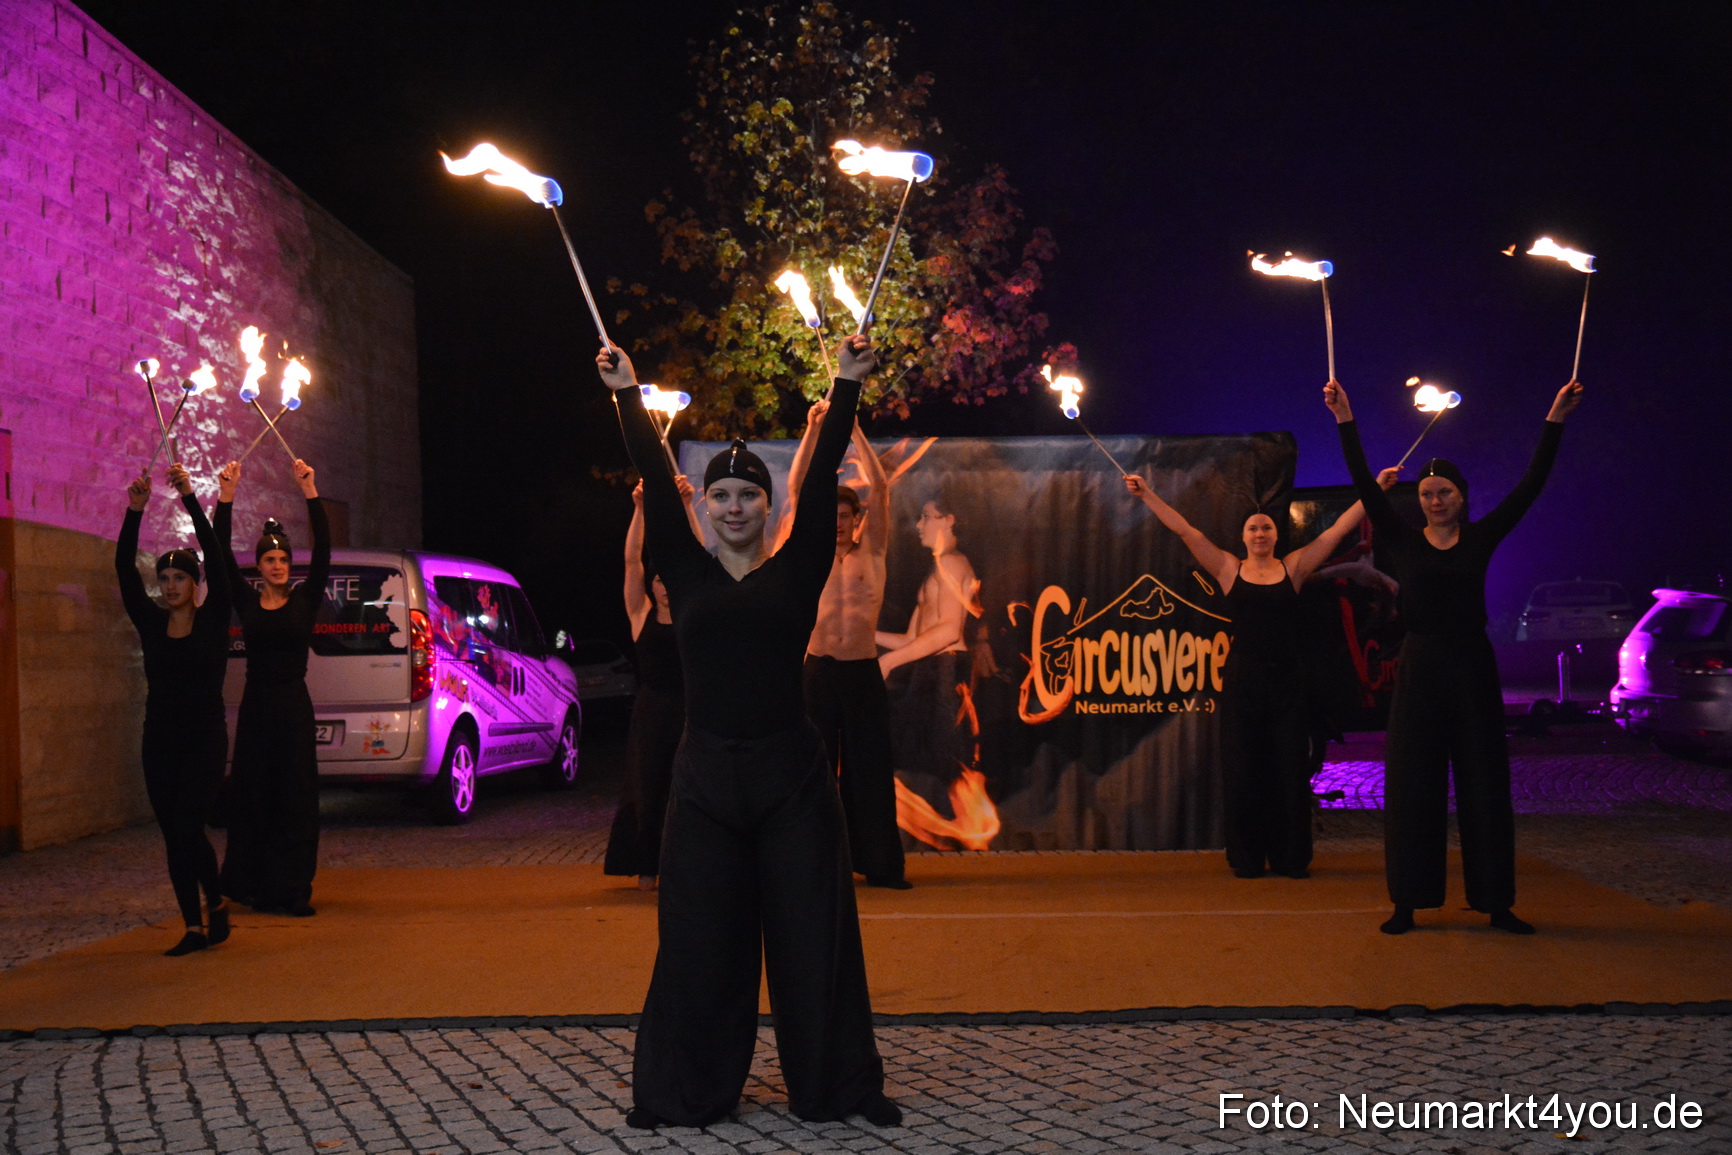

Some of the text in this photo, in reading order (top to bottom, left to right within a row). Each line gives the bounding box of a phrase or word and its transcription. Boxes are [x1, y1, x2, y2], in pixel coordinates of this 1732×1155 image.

[313, 623, 367, 634] SONDEREN
[1031, 585, 1231, 712] Circusvere
[1075, 700, 1164, 714] Neumarkt
[1167, 699, 1200, 713] e.V.
